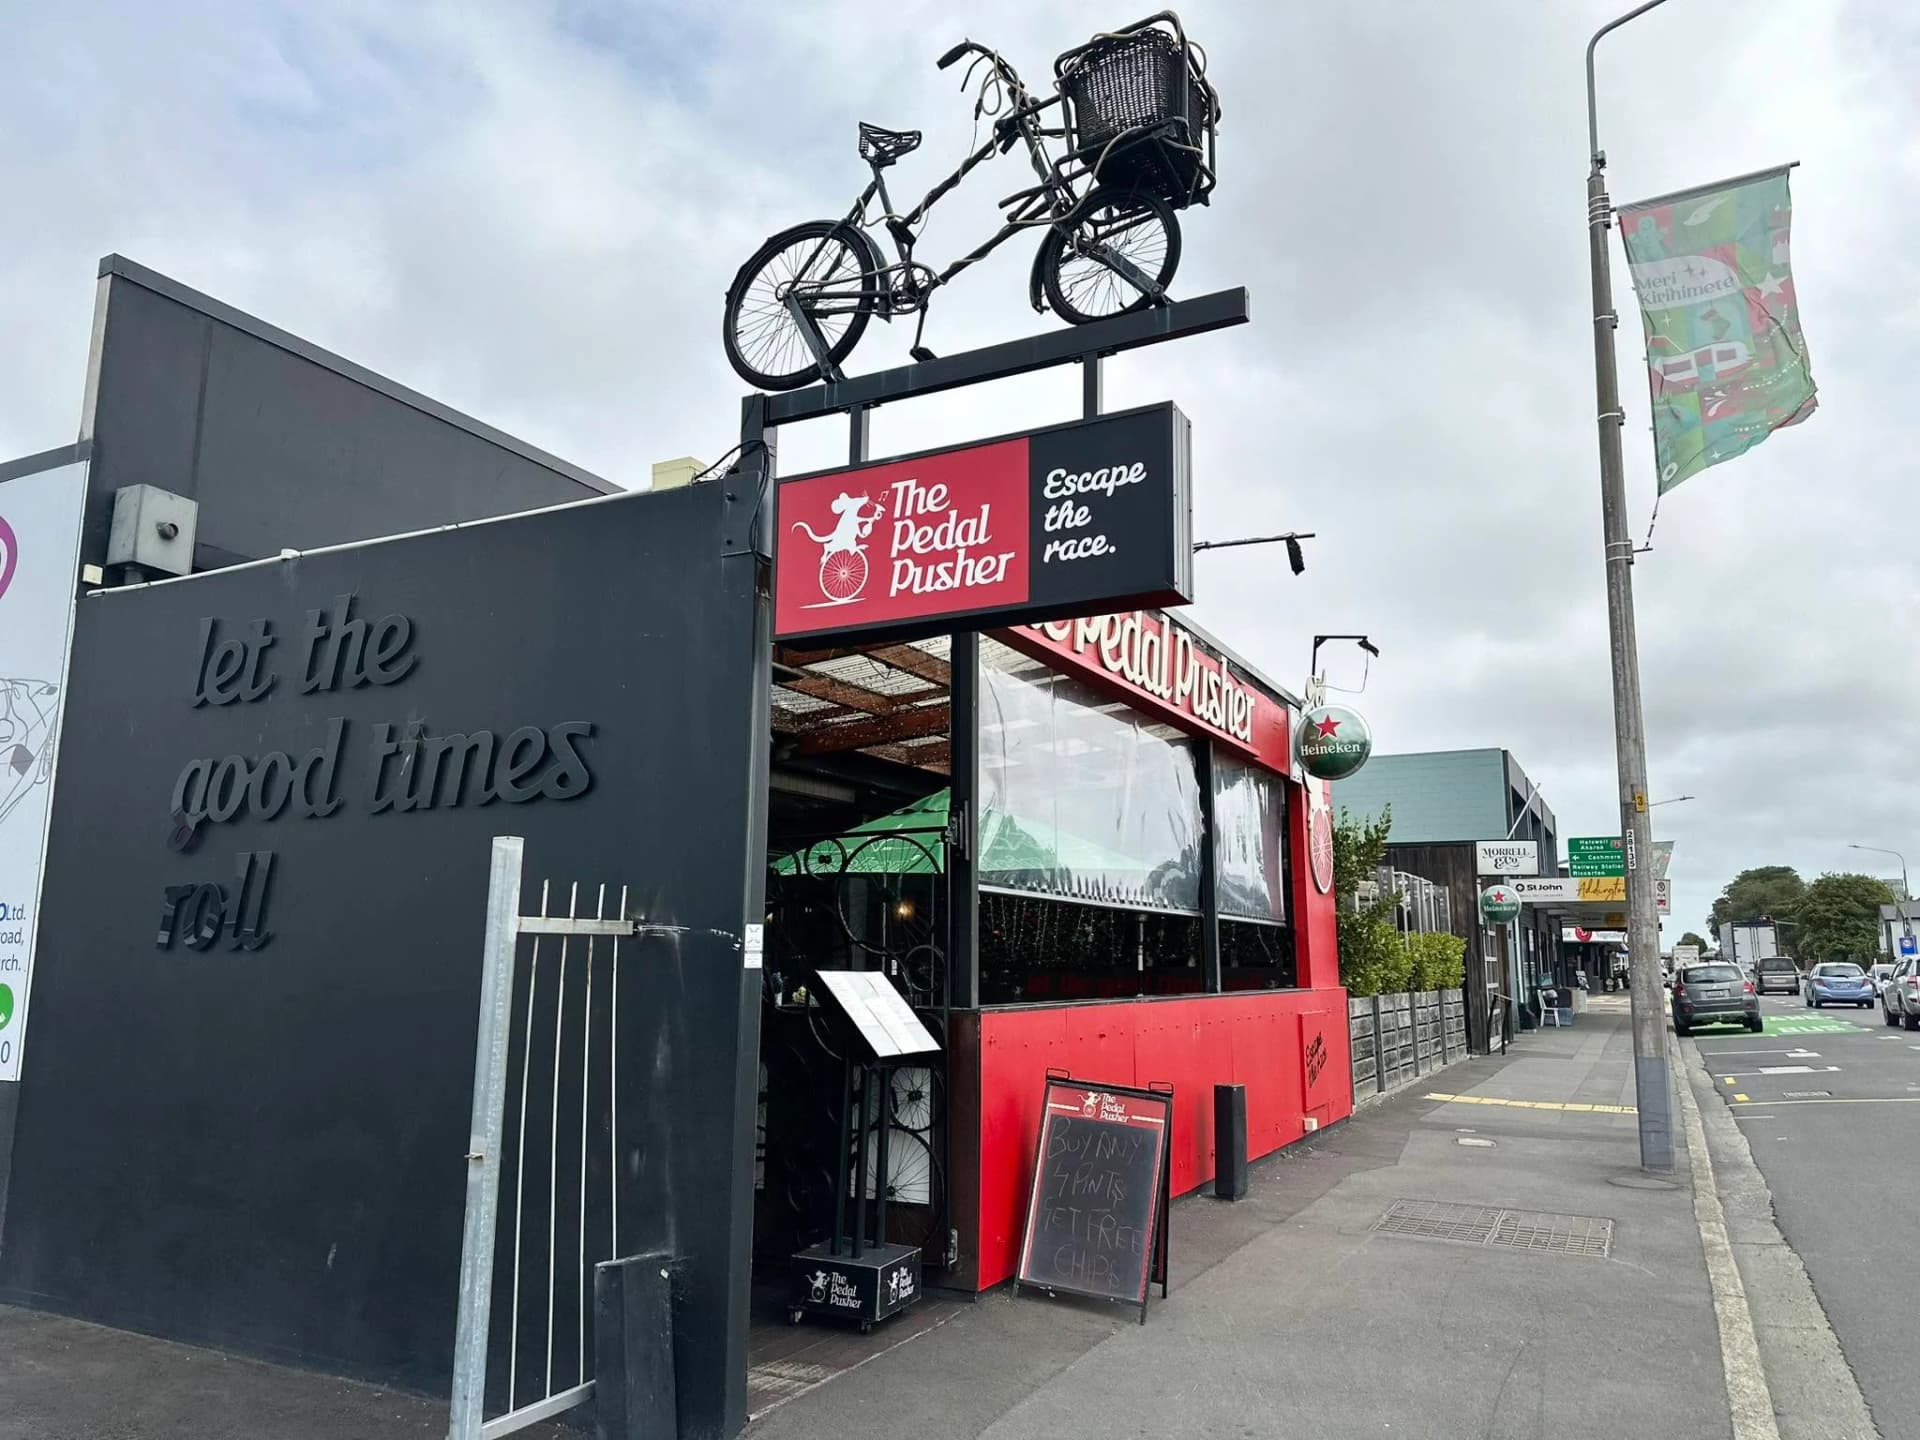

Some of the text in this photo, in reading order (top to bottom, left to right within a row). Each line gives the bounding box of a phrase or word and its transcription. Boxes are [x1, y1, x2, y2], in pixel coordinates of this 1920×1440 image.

[1638, 271, 1678, 290] Meri
[1043, 461, 1148, 500] Escape
[891, 478, 950, 519] The
[1043, 500, 1091, 533] the
[891, 504, 991, 559] Pedal
[1043, 533, 1116, 565] race.
[889, 549, 1016, 598] Pusher
[193, 592, 420, 709] let the
[1073, 609, 1256, 743] Pedal Pusher
[1300, 742, 1360, 757] Heineken
[166, 716, 595, 853] good times
[1636, 794, 1643, 806] 3
[1482, 847, 1534, 859] MORRELL
[1627, 830, 1635, 868] 28135
[156, 849, 277, 954] roll
[0, 928, 24, 945] oad,
[1101, 1102, 1125, 1113] Pedal
[1102, 1093, 1116, 1103] The
[1100, 1110, 1129, 1122] Pusher
[831, 1271, 847, 1284] The
[829, 1294, 862, 1309] Pusher
[830, 1285, 857, 1297] Pedal
